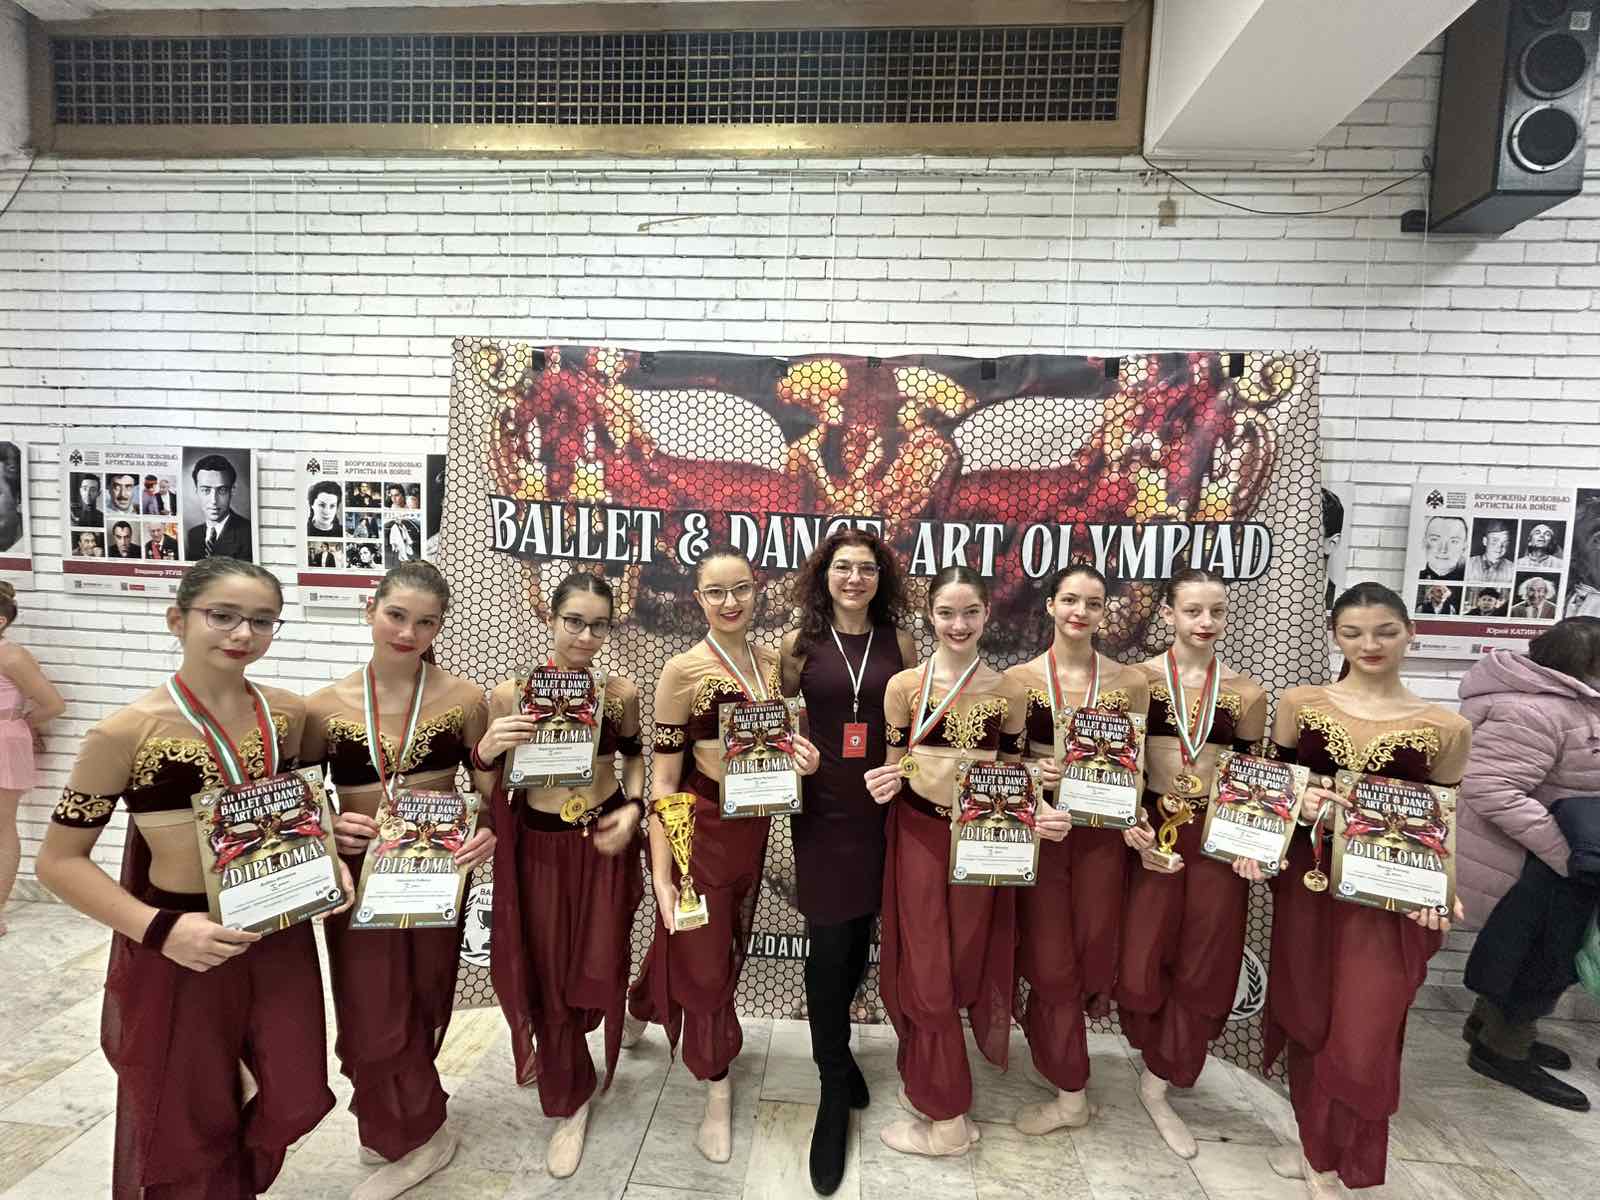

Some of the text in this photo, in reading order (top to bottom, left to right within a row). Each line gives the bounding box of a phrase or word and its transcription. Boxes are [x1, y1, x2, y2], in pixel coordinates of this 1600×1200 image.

[491, 498, 661, 562] BALLET
[678, 513, 709, 566] &
[909, 522, 1004, 577] ART
[532, 680, 559, 688] BALLET
[568, 680, 591, 689] DANCE
[530, 730, 587, 744] IPLOMA
[733, 758, 789, 774] DIPLOMA
[1070, 766, 1129, 787] DIPLOMA
[237, 779, 302, 800] INTERNATIONAL
[970, 774, 996, 784] BALLET
[1005, 776, 1028, 786] DANCE
[221, 796, 260, 816] BALLET
[273, 785, 305, 802] DANCE
[1356, 789, 1391, 803] BALLET
[1403, 797, 1434, 810] DANCE
[1371, 785, 1431, 800] INTERNATIONAL
[234, 798, 296, 823] ART OLYMPIAD
[1365, 800, 1423, 817] ART OLYMPIAD
[1221, 807, 1280, 833] DIPLOMA
[966, 827, 1027, 843] DIPLOMA
[229, 844, 320, 887] DIPLOMA
[380, 857, 454, 874] DIPLOMA
[1353, 840, 1436, 871] DIPLOMA
